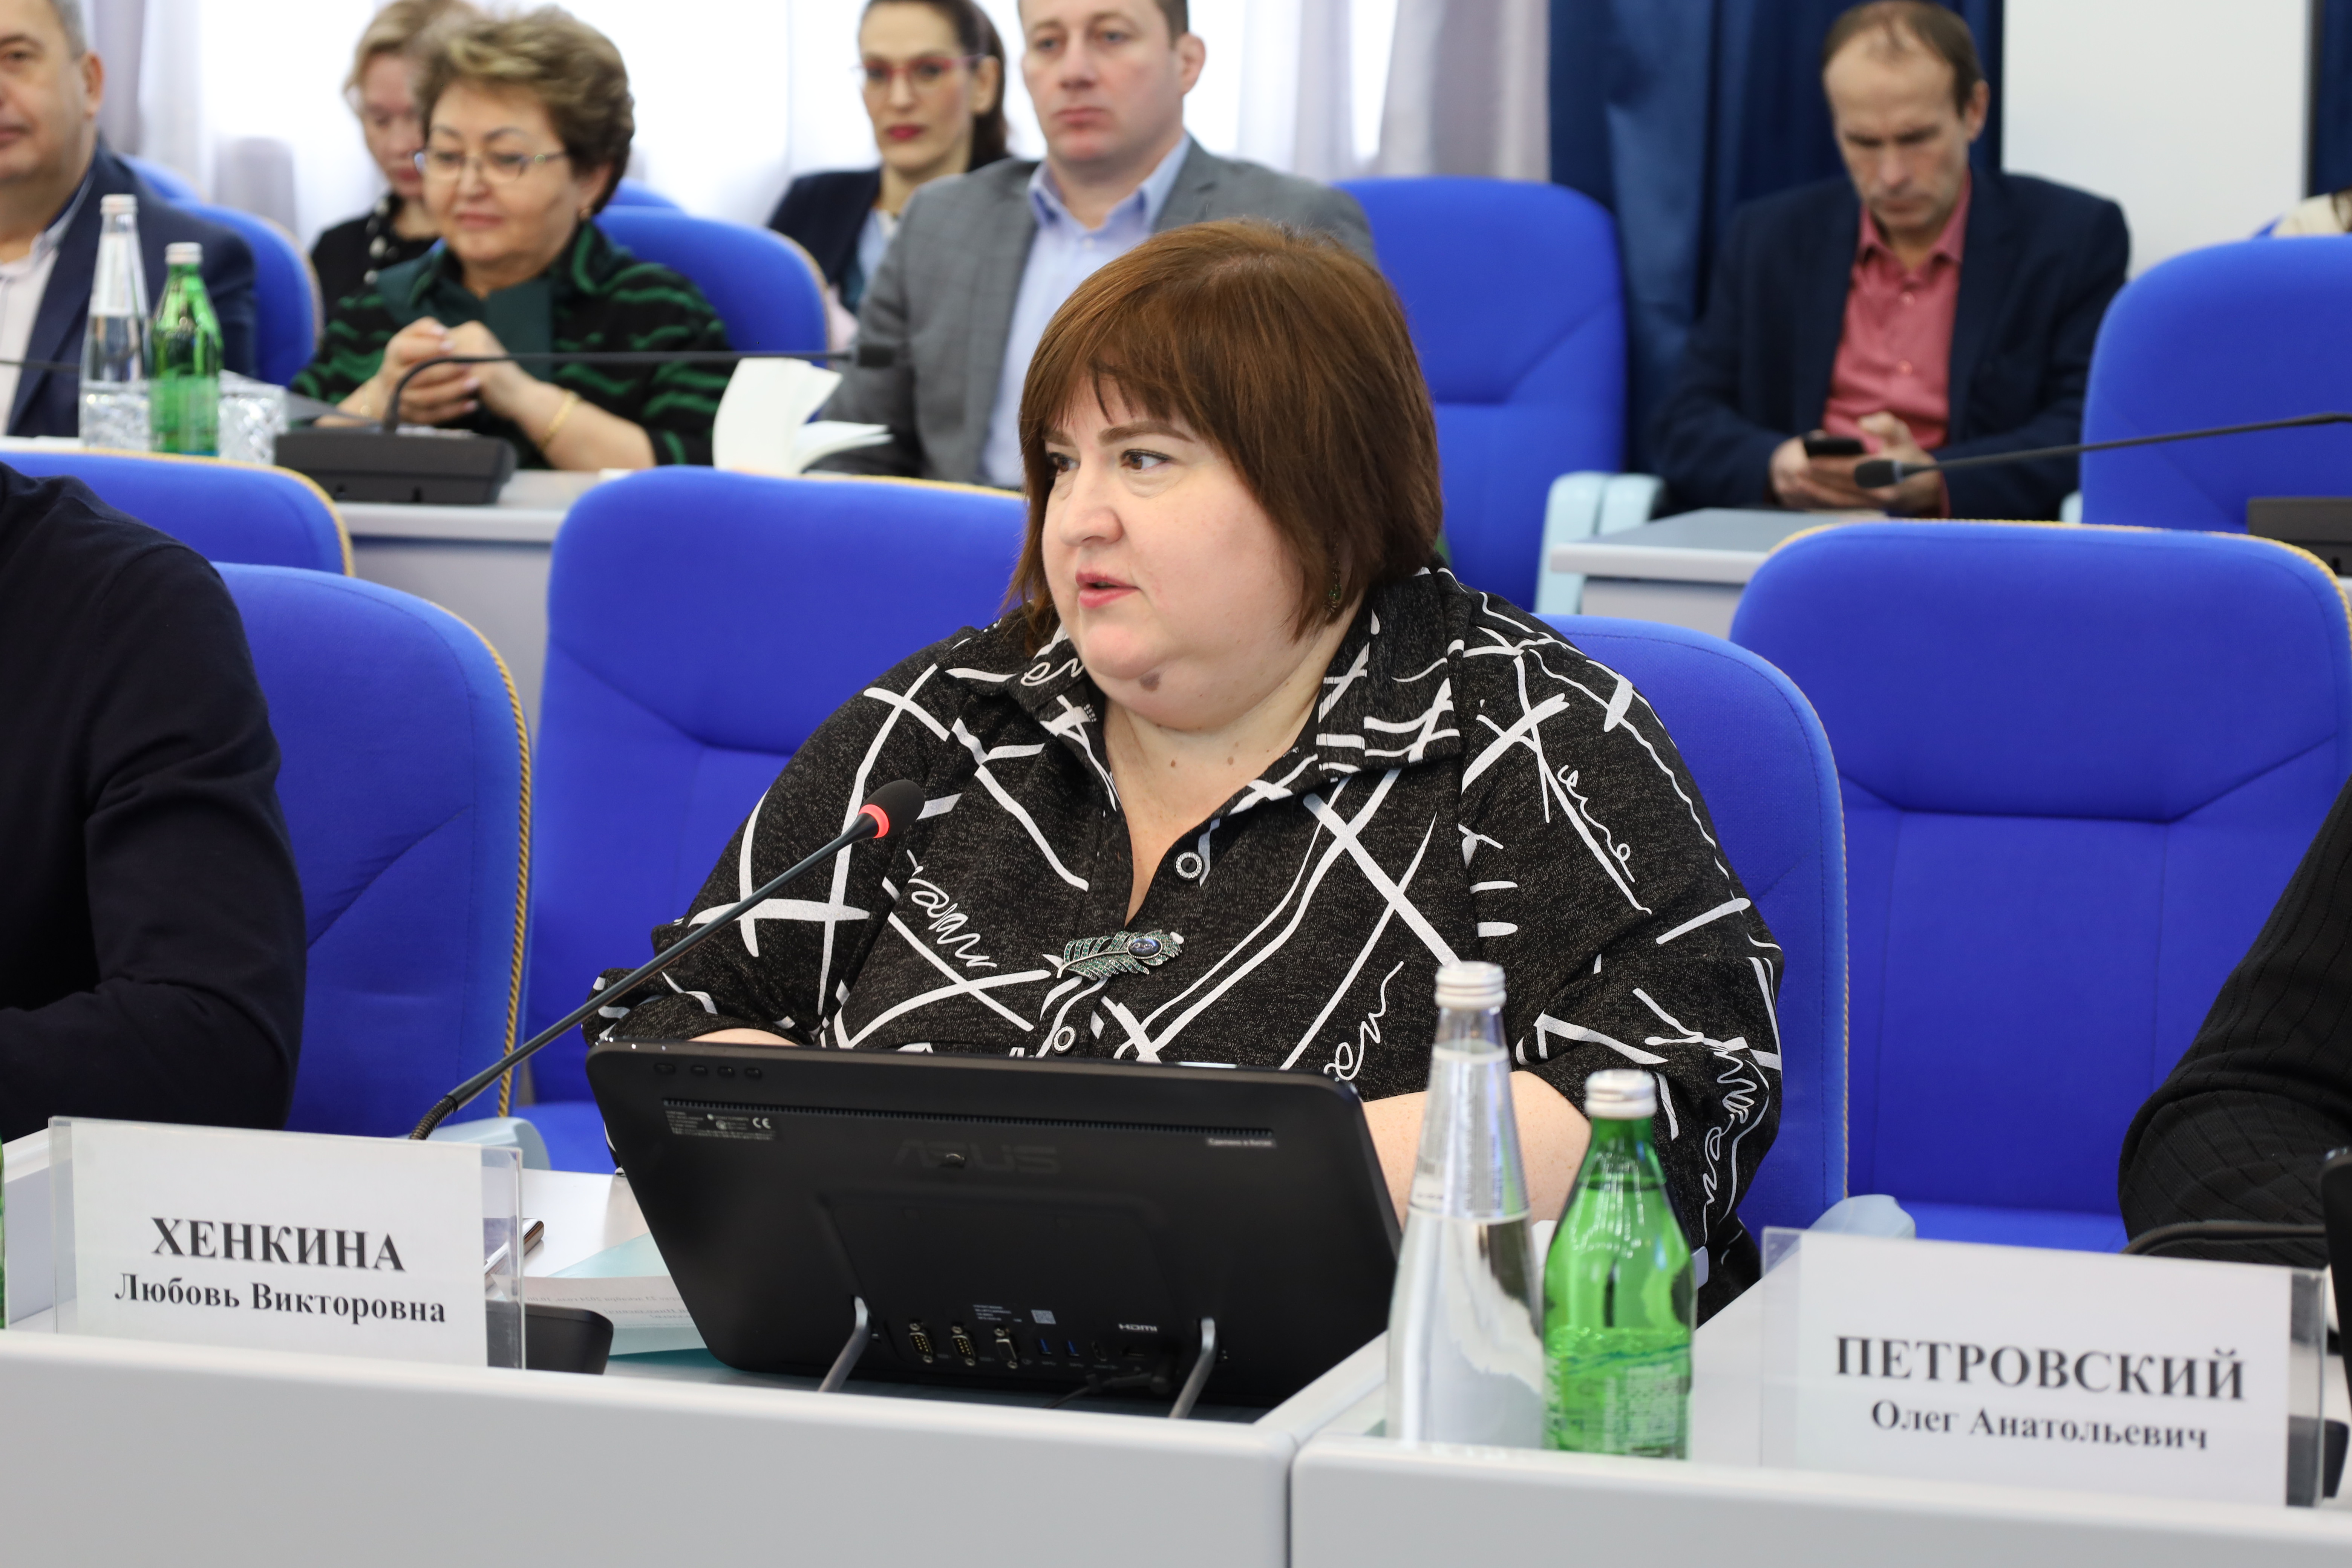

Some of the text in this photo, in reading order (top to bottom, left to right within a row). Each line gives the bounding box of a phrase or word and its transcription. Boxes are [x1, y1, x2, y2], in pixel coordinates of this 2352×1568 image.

[892, 1137, 1062, 1173] ASUS
[152, 1217, 406, 1272] ХЕНКИНА
[114, 1273, 446, 1326] Любовь Викторовна
[1118, 1323, 1158, 1332] HDMI
[1836, 1336, 2244, 1401] ПЕТРОВСКИЙ
[1871, 1400, 2208, 1450] Олег Анатольевич
